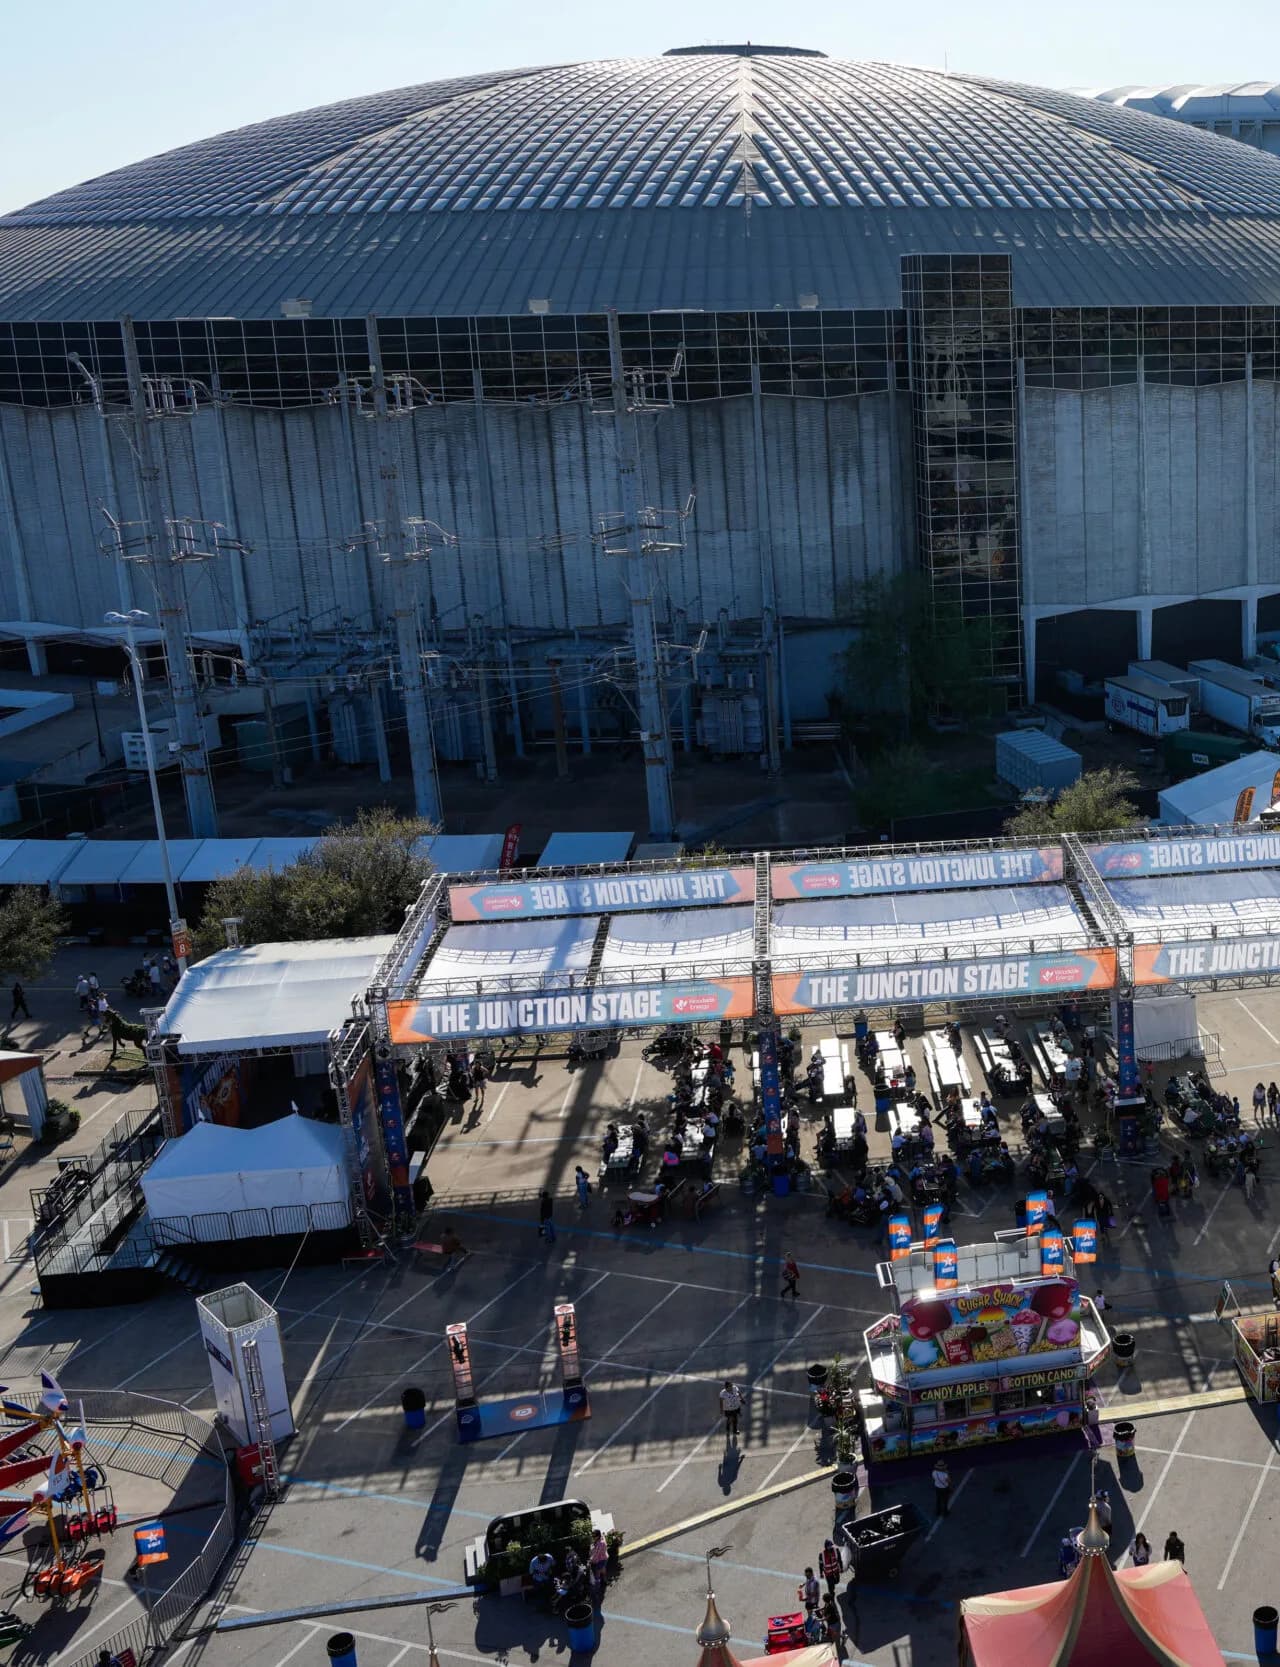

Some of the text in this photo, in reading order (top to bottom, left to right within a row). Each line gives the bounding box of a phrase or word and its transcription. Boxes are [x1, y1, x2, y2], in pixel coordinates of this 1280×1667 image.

[180, 943, 186, 953] 8
[1168, 946, 1204, 975] THE
[809, 961, 1030, 1005] THE JUNCTION STAGE
[427, 990, 661, 1033] THE JUNCTION STAGE
[957, 1287, 1025, 1316] SUGAR SHACK
[234, 1317, 276, 1339] TICKETS
[1008, 1368, 1079, 1388] COTTON CANDY
[921, 1383, 990, 1401] CANDY APPLES
